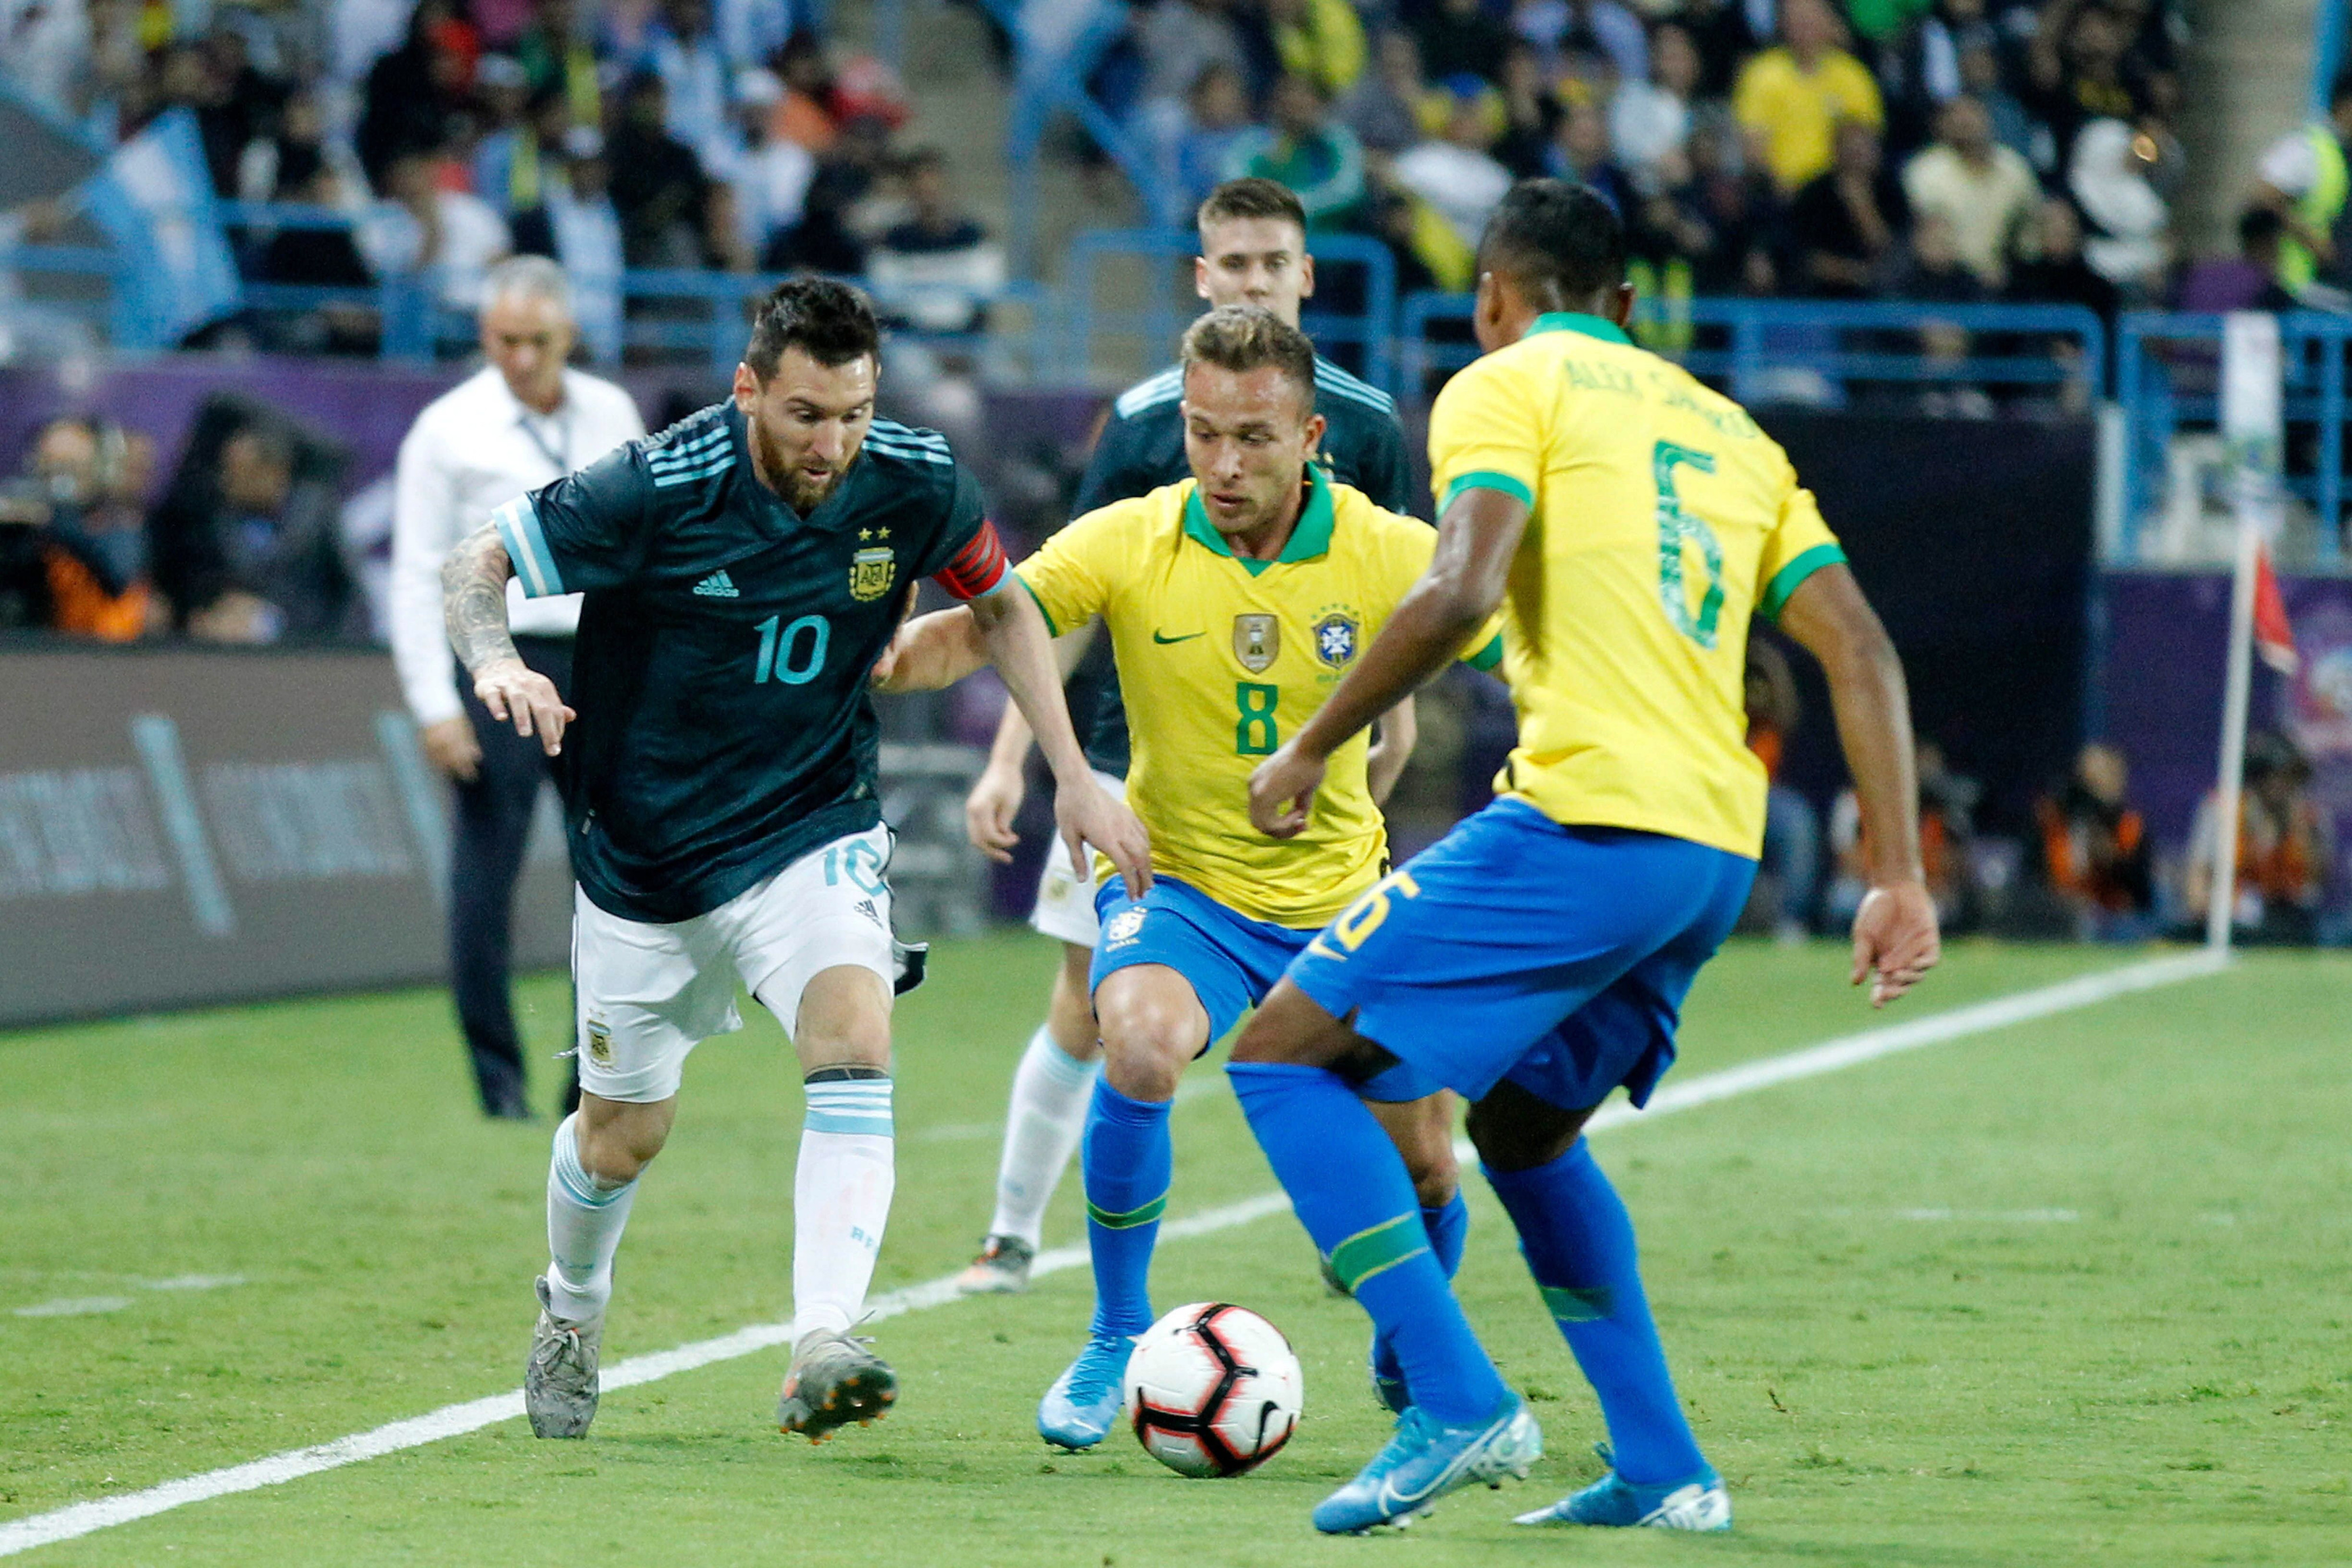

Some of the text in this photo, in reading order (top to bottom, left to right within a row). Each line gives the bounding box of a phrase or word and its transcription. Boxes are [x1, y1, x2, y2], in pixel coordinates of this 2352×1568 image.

[1653, 440, 1725, 650] 6
[753, 615, 830, 686] 10
[1237, 682, 1278, 755] 8
[1335, 870, 1421, 952] 6
